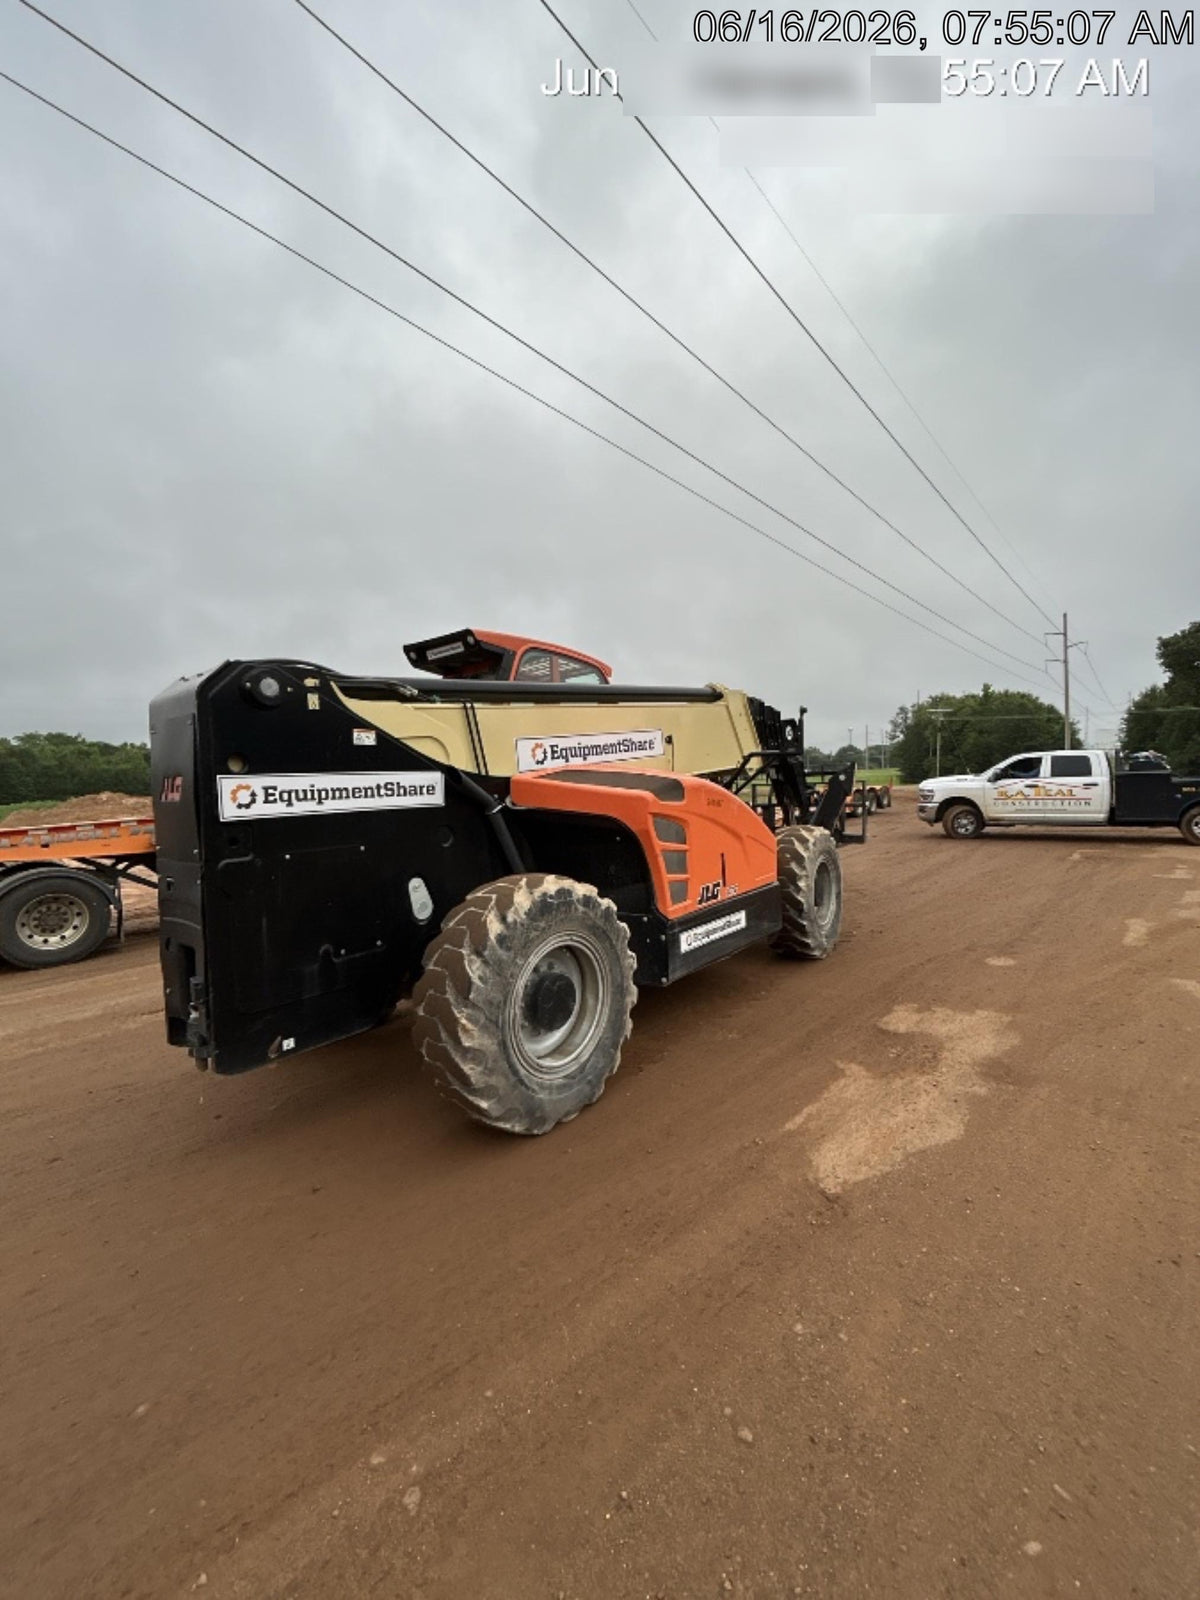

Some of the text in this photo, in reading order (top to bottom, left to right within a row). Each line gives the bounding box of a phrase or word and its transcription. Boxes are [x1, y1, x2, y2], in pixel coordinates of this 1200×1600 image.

[549, 737, 656, 763] EquipmentShare
[261, 781, 437, 808] EquipmentShare
[697, 880, 721, 906] JLG
